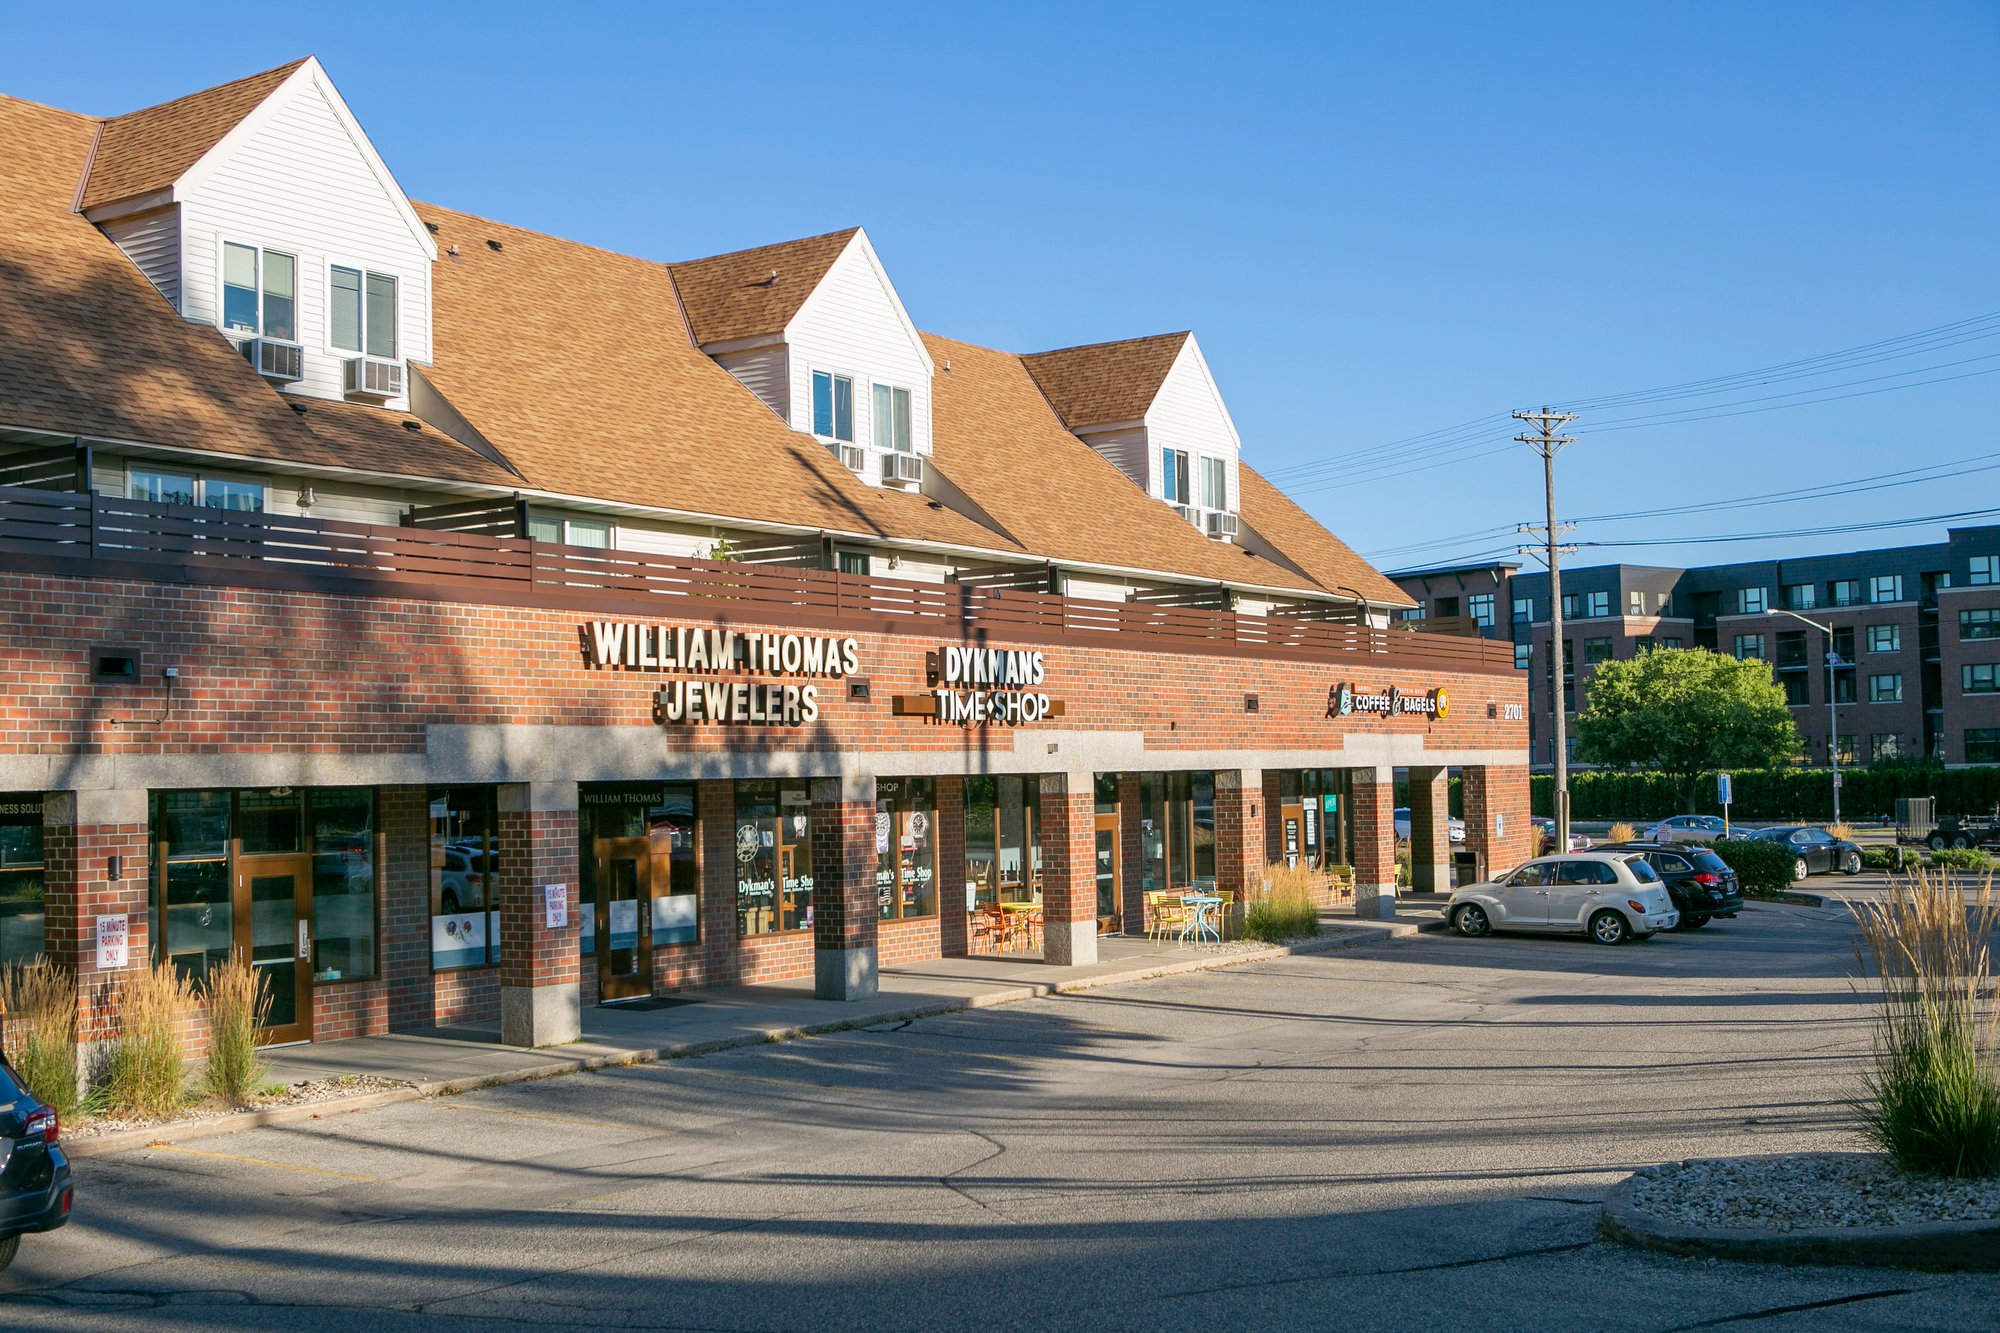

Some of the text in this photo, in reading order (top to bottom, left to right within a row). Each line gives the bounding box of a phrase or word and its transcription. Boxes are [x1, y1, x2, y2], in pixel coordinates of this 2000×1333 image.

[592, 621, 859, 675] WILLIAM THOMAS
[946, 646, 1045, 685] DYKMANS
[667, 680, 819, 723] JEWELERS
[936, 689, 1050, 722] TIME SHOP
[1356, 695, 1390, 711] COFFEE
[1404, 697, 1436, 712] BAGELS
[1504, 703, 1523, 720] 2701
[876, 782, 899, 792] SHOP
[584, 793, 661, 804] WILLIAM THOMAS
[0, 803, 19, 814] NESS
[877, 869, 894, 881] man's
[901, 867, 915, 879] Time
[917, 866, 931, 880] Shop
[738, 873, 814, 896] Dykman's Time Sho
[106, 919, 125, 932] MINUTE
[101, 935, 123, 947] PARKING
[105, 949, 119, 961] ONLY
